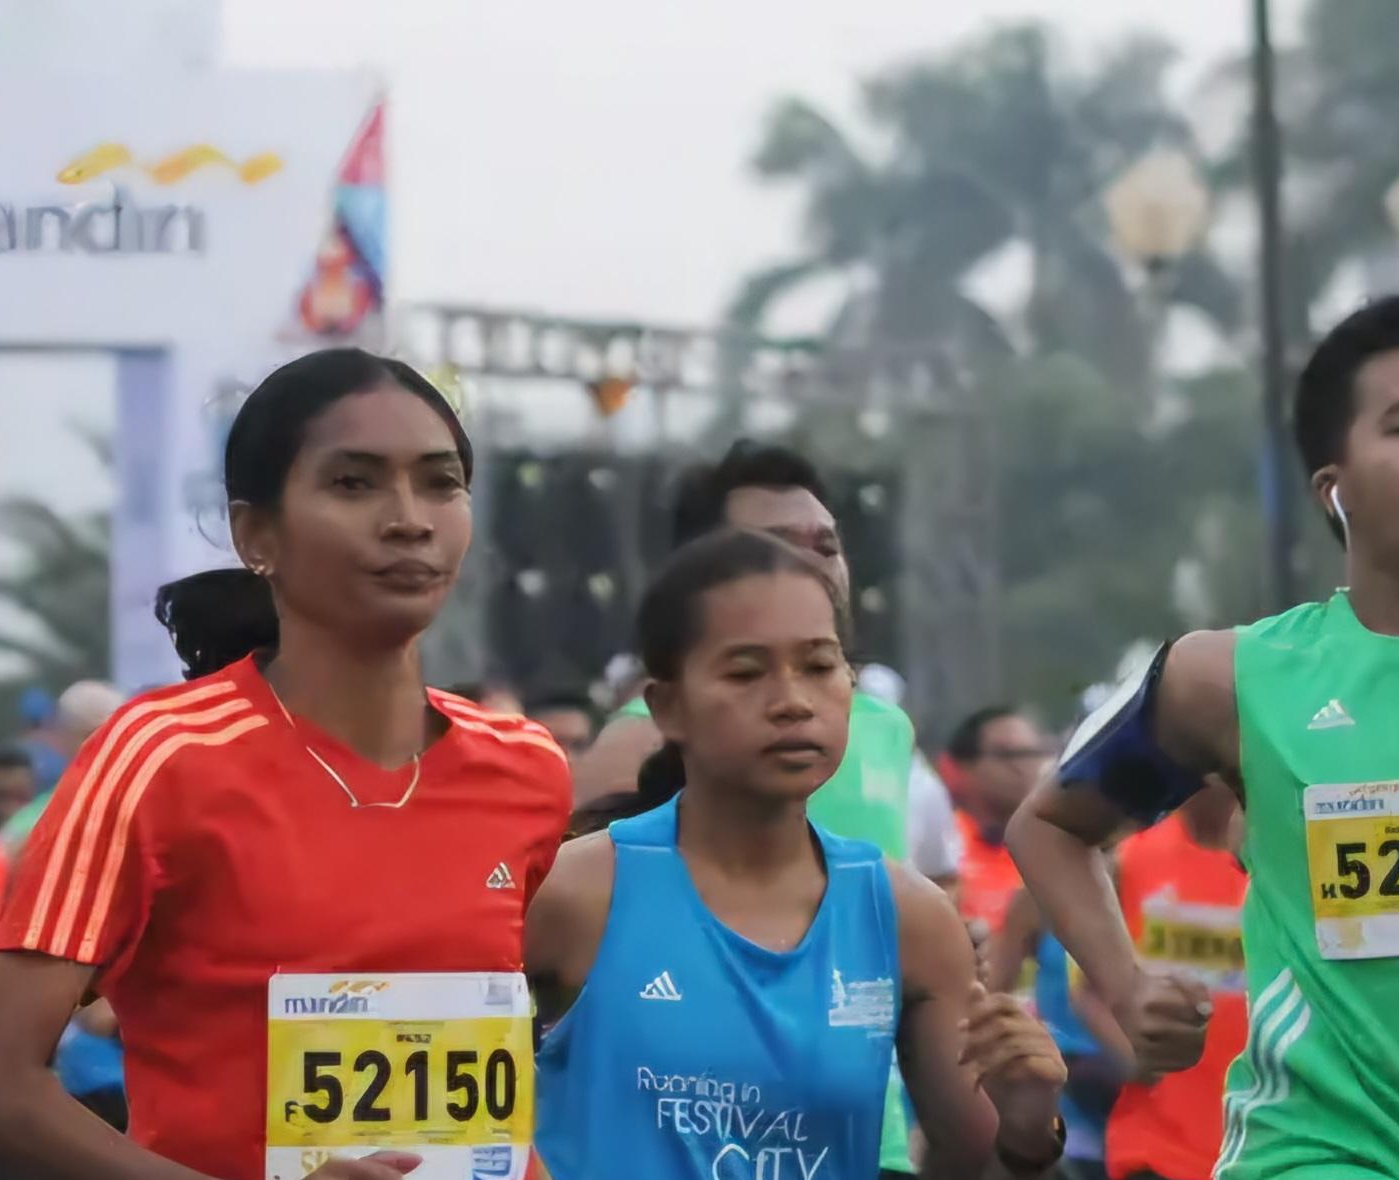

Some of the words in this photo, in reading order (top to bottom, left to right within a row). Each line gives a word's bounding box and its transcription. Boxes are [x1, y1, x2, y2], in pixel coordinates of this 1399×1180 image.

[637, 1066, 736, 1104] Running
[741, 1082, 762, 1104] in
[657, 1097, 809, 1142] FESTIVAL
